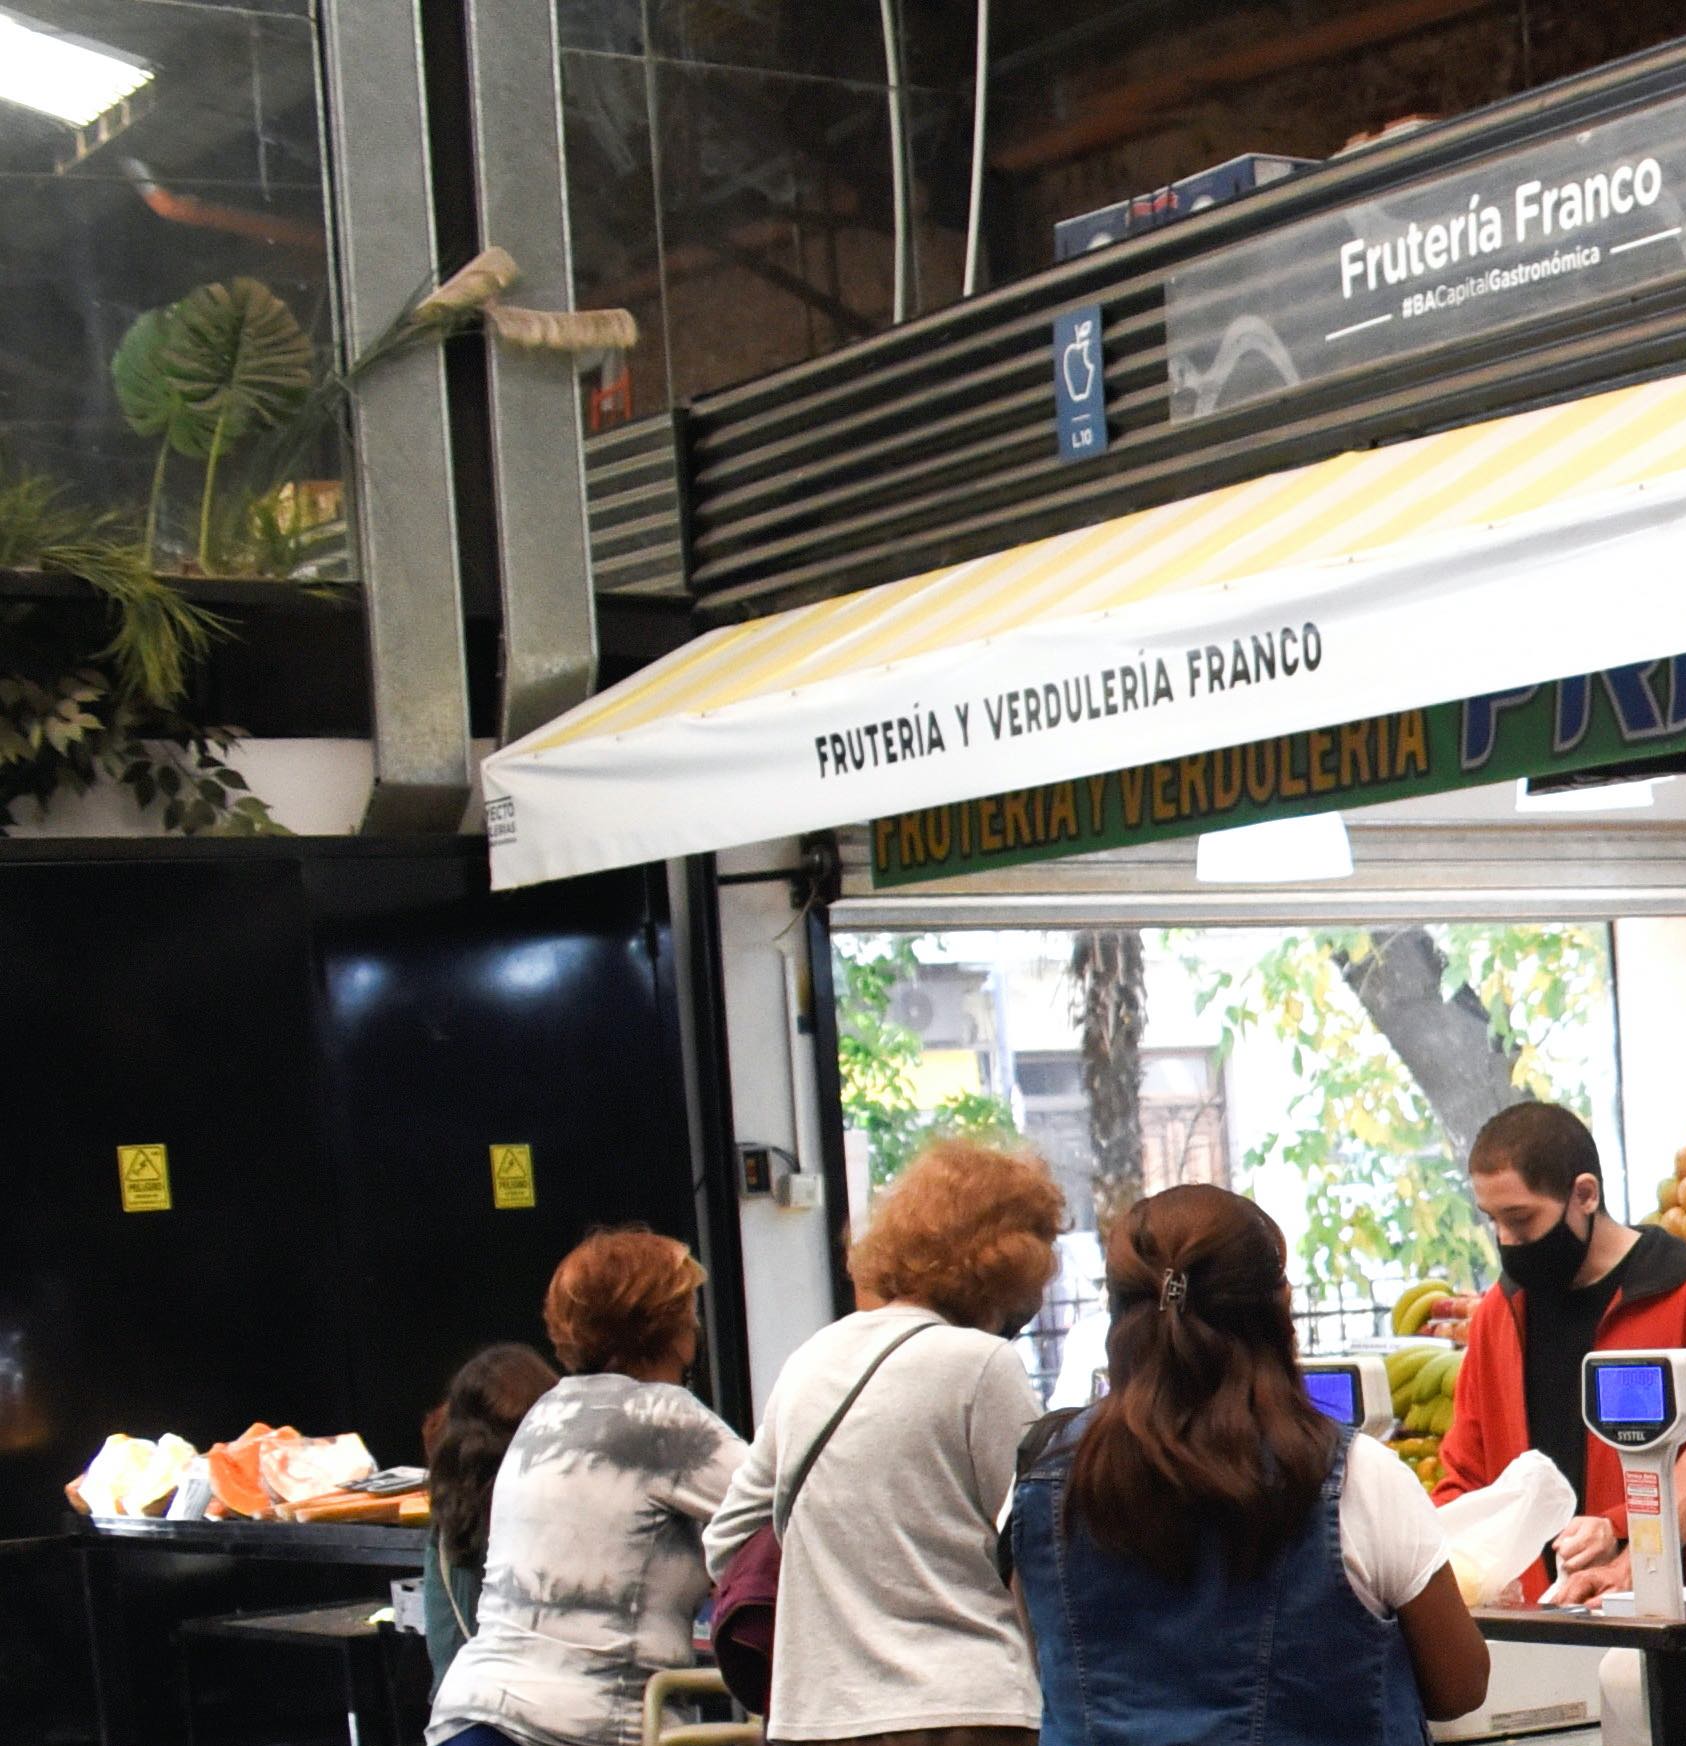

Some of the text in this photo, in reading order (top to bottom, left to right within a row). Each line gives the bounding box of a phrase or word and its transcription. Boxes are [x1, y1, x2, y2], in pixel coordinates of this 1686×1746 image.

[1340, 157, 1663, 299] Frutería Franco
[815, 622, 1323, 778] FRUTERÍA Y VERDULERÍA FRANCO
[1617, 1431, 1645, 1441] SYSTEL
